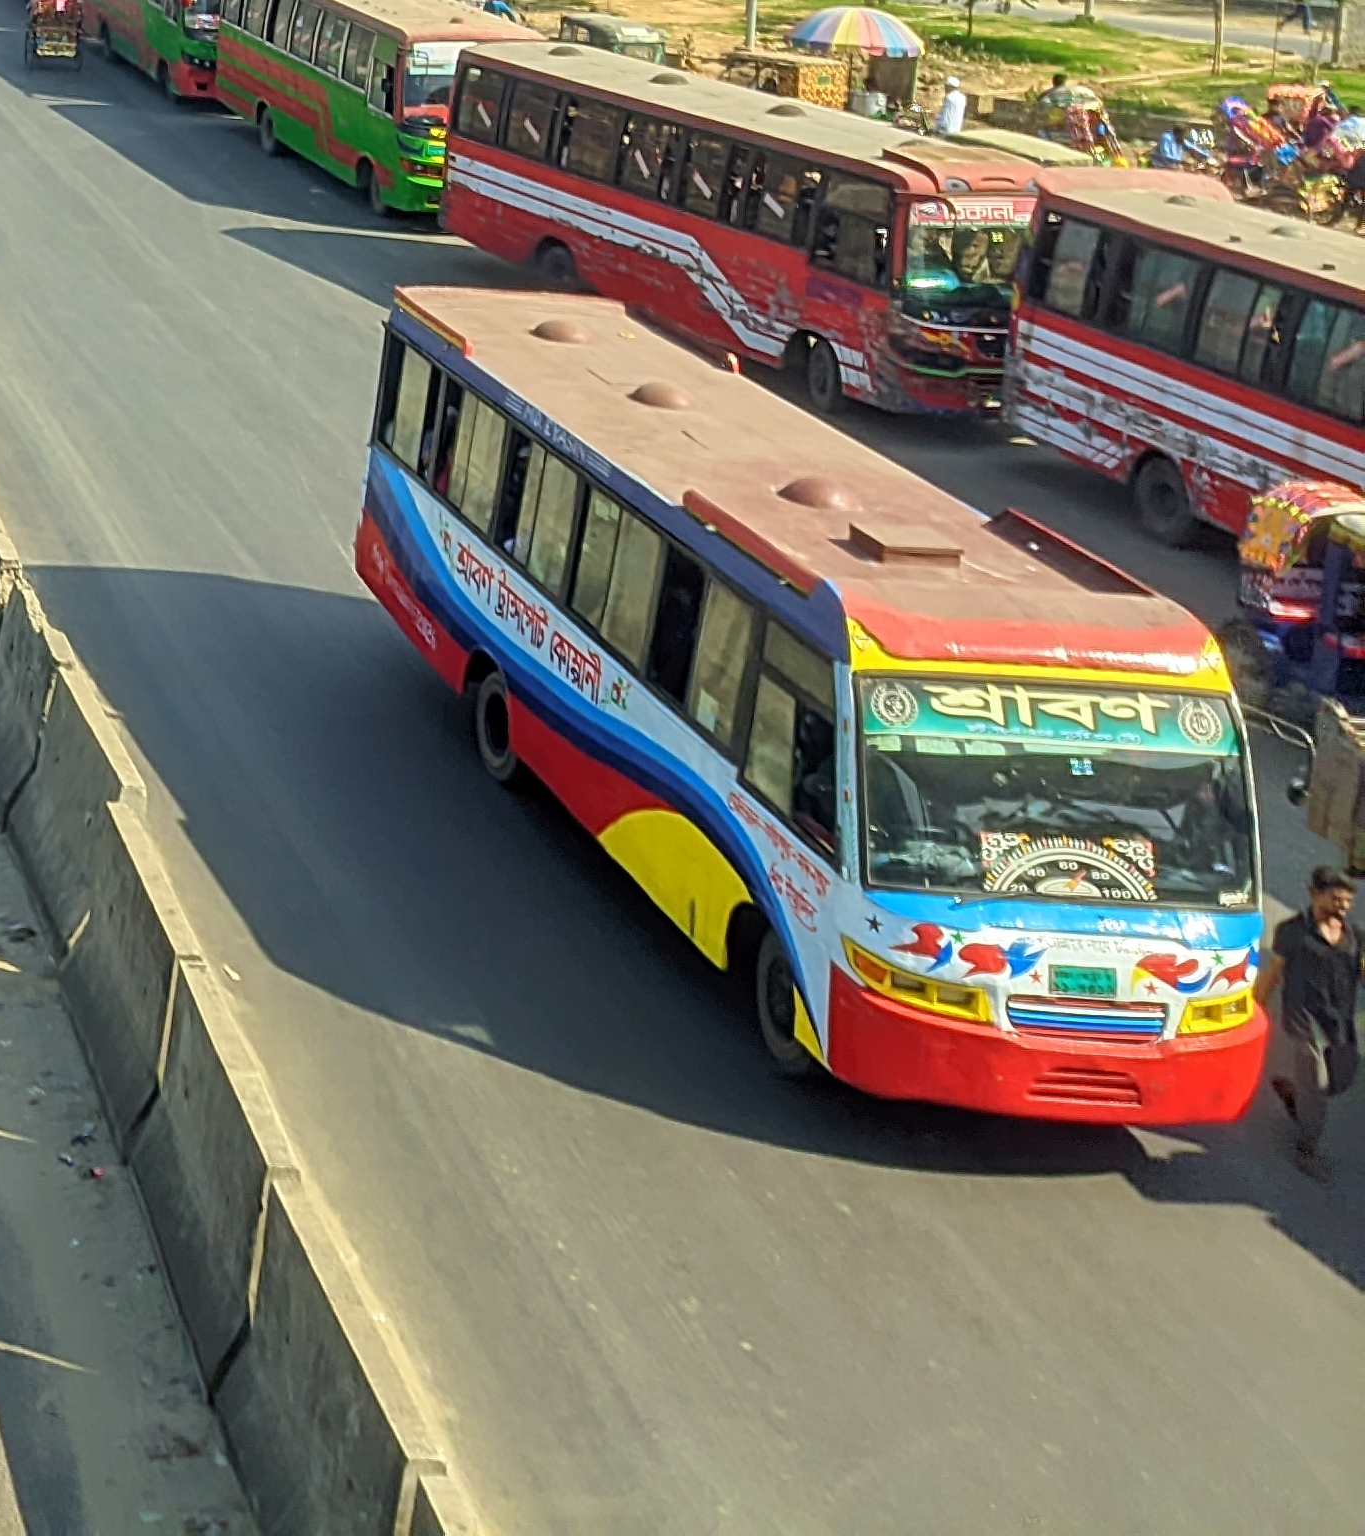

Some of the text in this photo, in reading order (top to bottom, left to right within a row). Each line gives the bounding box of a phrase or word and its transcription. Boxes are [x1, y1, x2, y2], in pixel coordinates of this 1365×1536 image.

[456, 541, 495, 605] শ্রাবণ
[921, 683, 1171, 734] শ্রাবণ
[1057, 861, 1078, 870] 60
[1026, 868, 1110, 880] 40 80
[1102, 888, 1132, 900] 100
